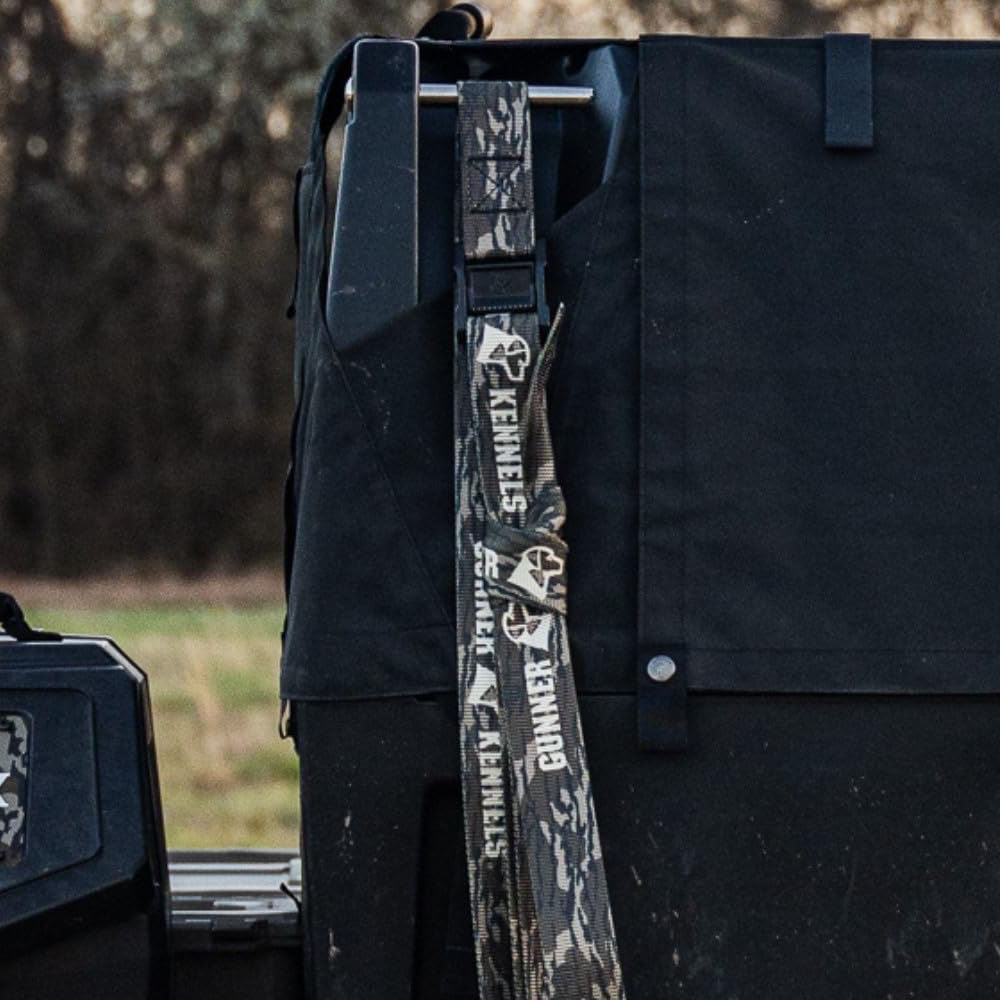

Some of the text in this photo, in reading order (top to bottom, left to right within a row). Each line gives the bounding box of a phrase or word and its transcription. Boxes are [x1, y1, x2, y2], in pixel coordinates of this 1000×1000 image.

[489, 388, 528, 513] KENNELS
[524, 659, 567, 772] GUNNER
[478, 730, 507, 858] KENNELS
